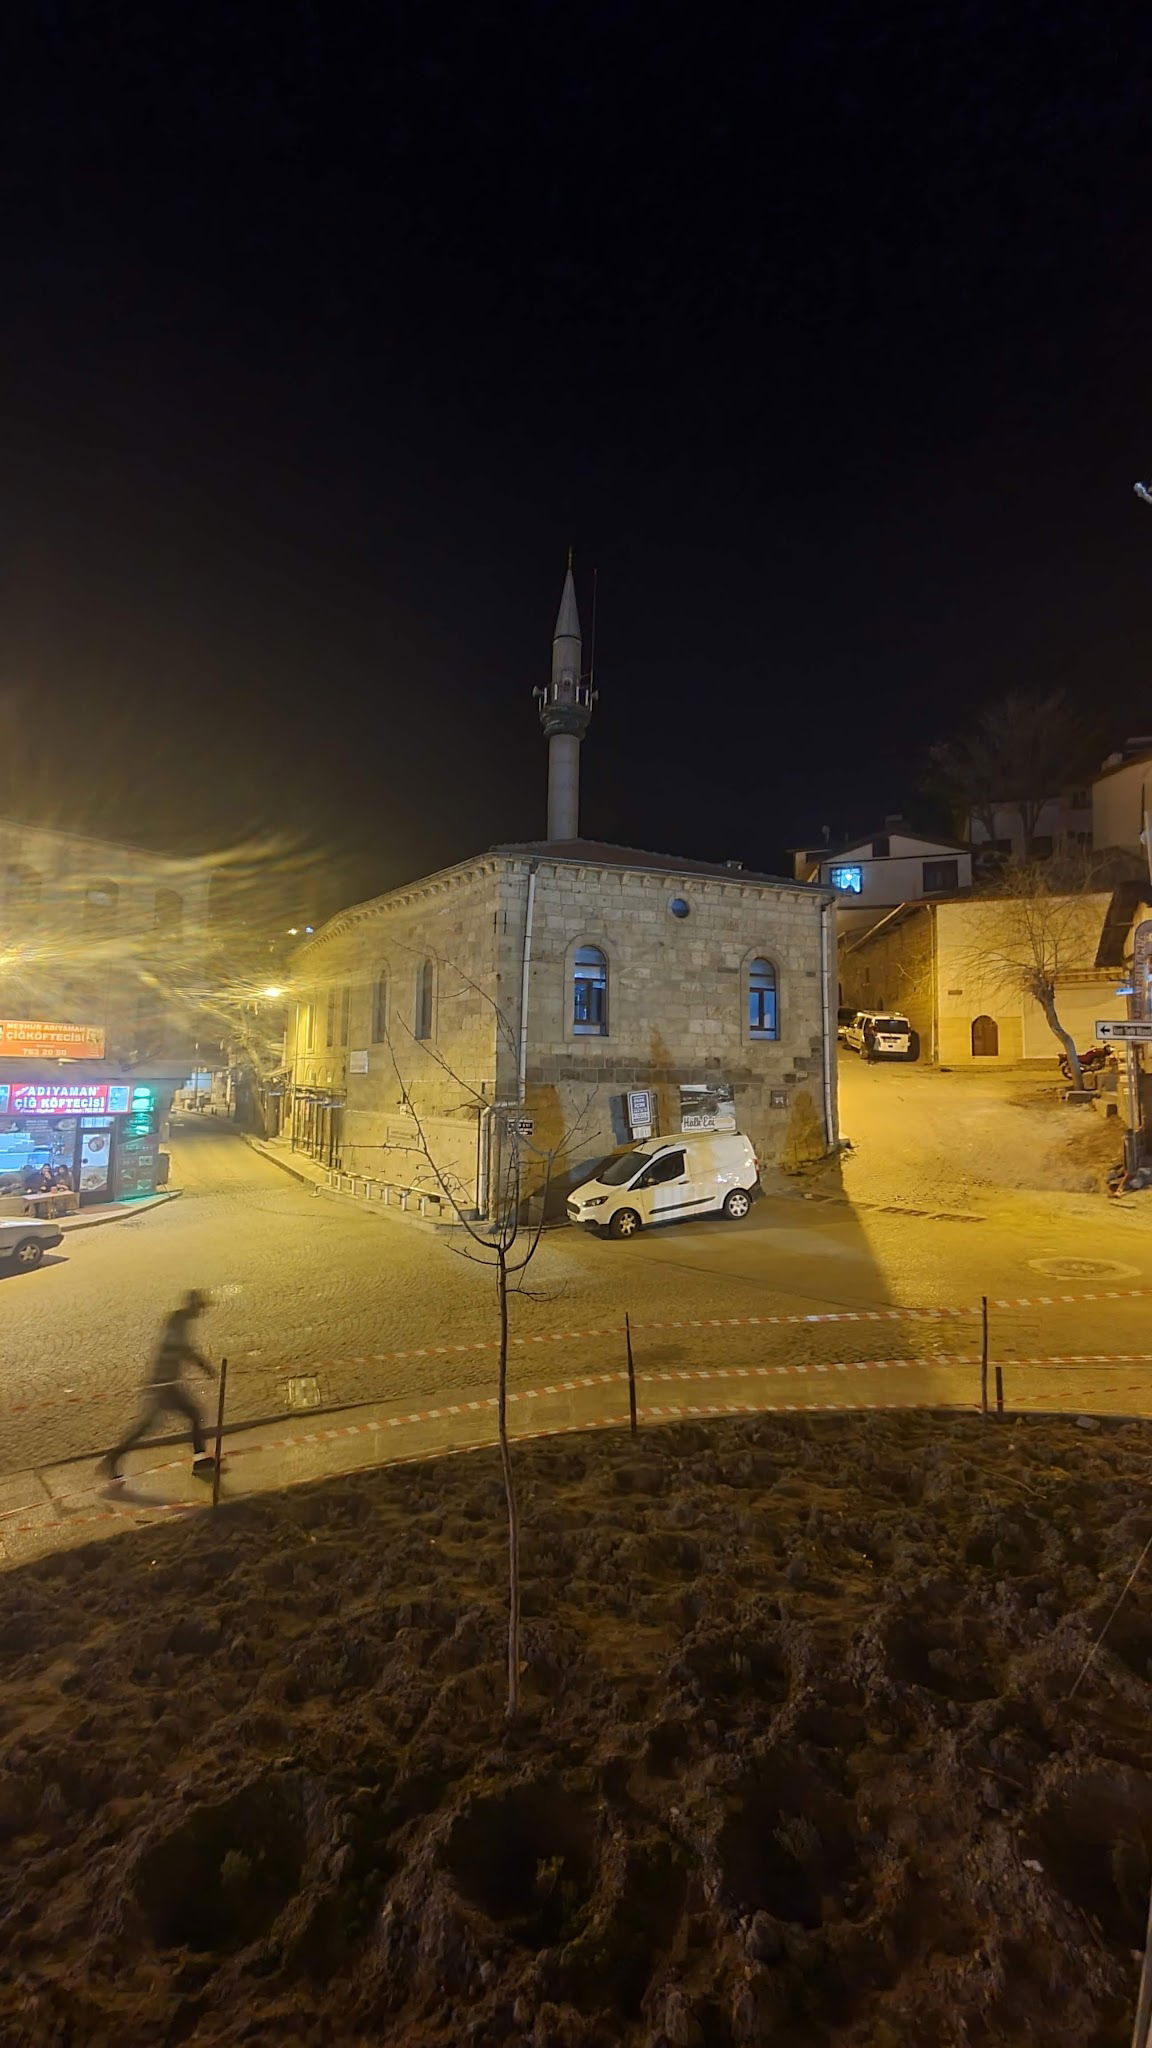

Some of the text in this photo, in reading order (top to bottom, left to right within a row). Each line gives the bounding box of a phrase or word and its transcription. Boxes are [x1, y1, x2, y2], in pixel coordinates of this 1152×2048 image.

[44, 1024, 86, 1032] ADIYAMAN
[28, 1086, 97, 1096] ADIYAMAN
[15, 1096, 105, 1110] ÇİĞ KÖFTECİSİ
